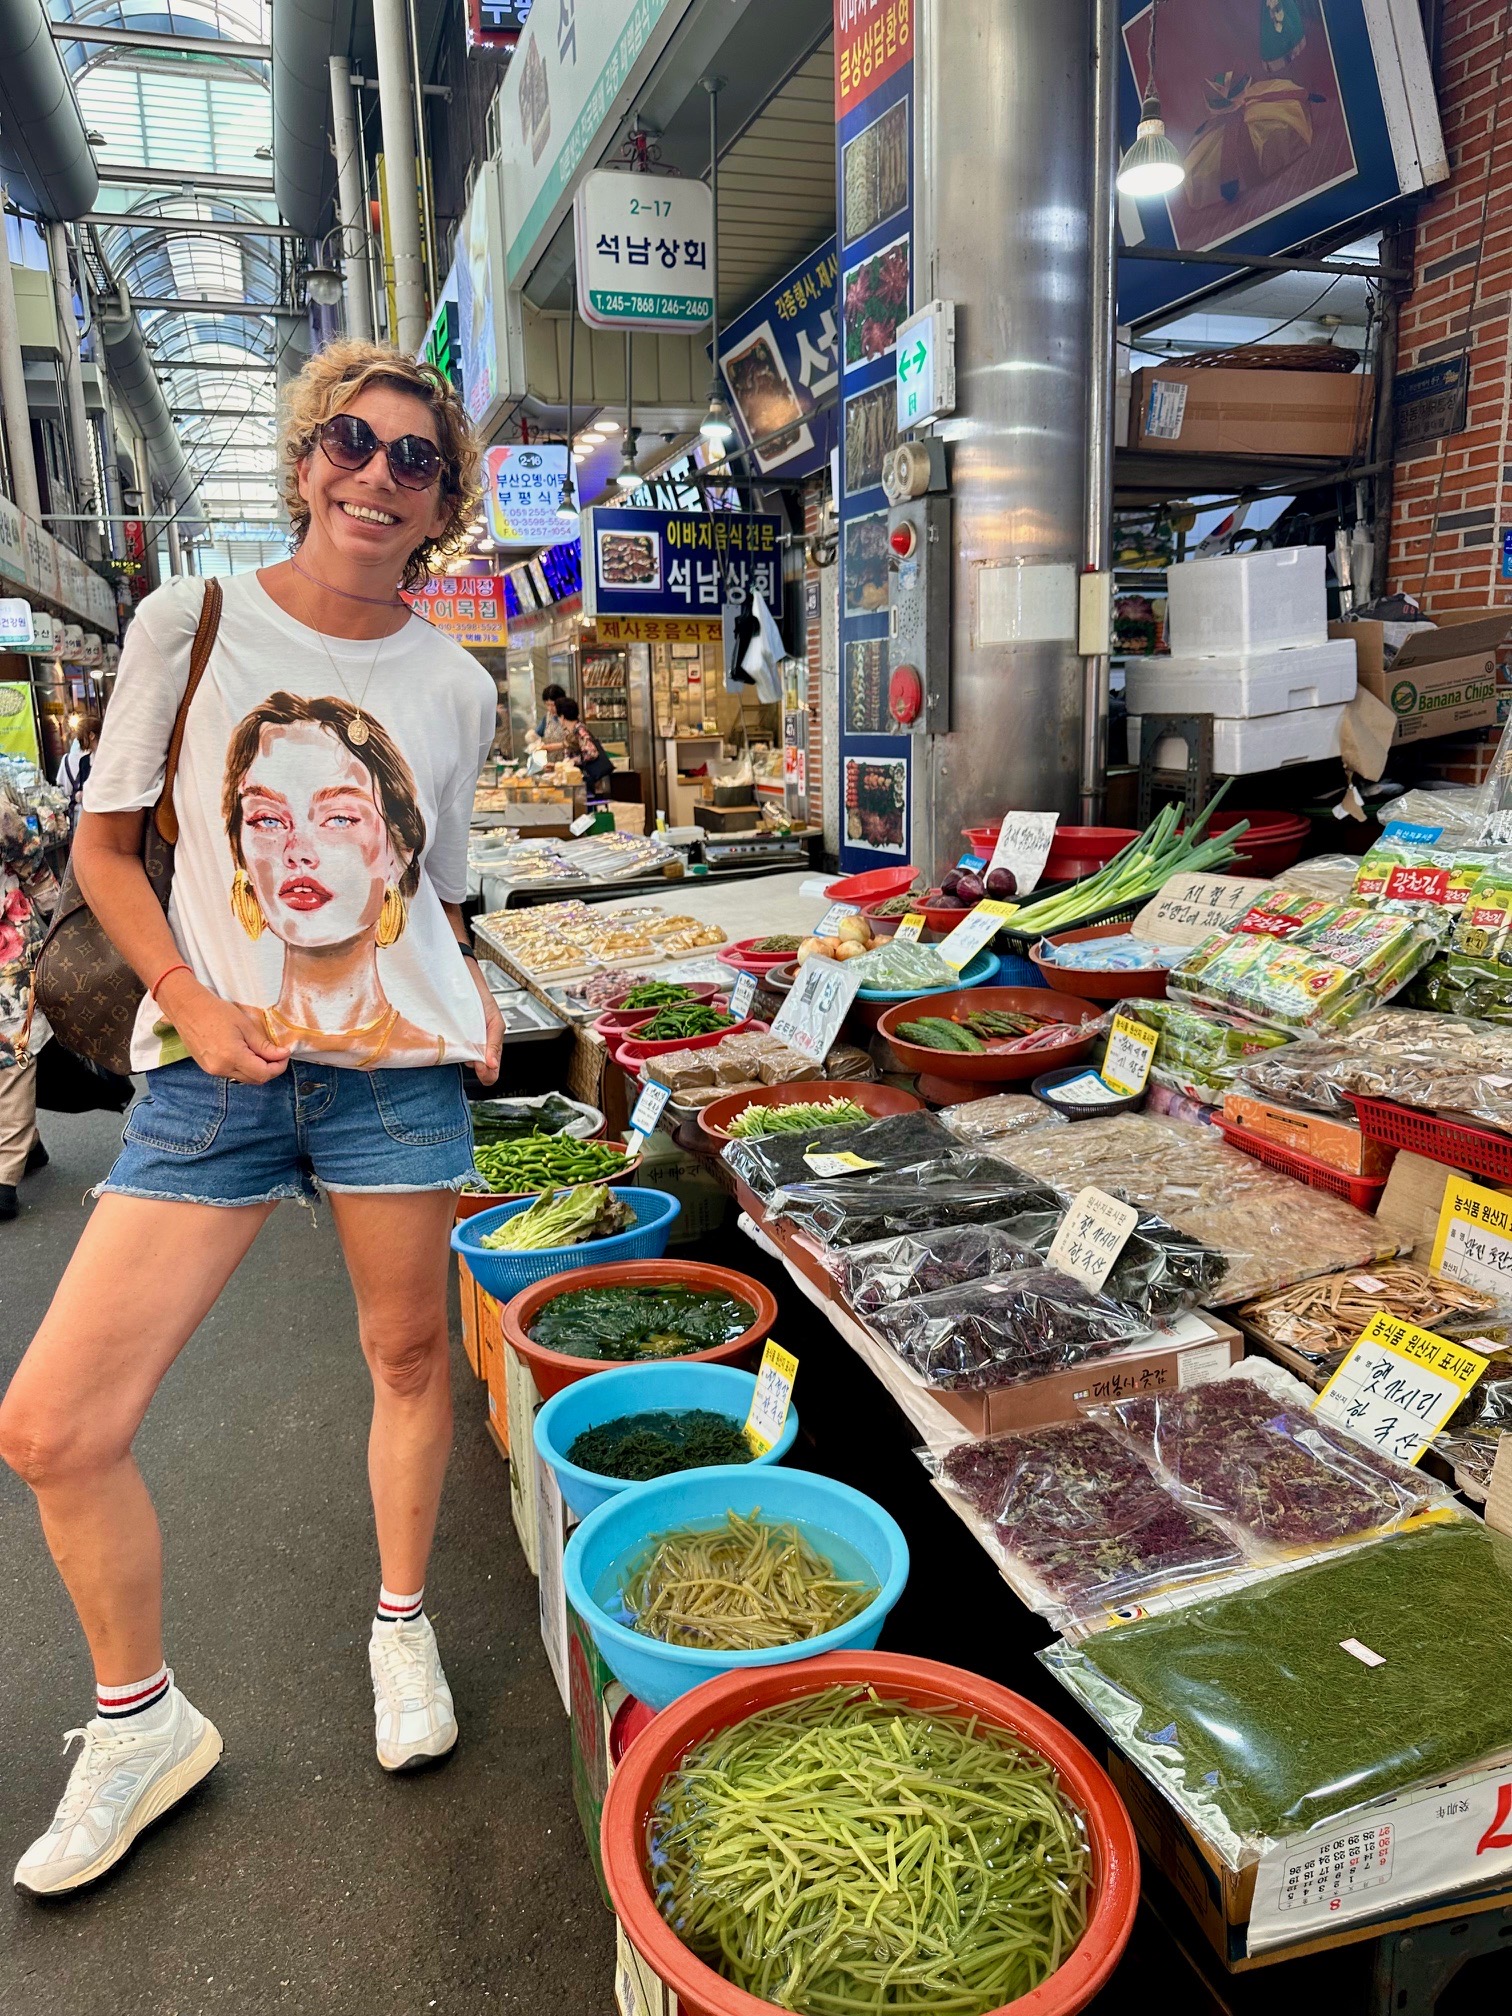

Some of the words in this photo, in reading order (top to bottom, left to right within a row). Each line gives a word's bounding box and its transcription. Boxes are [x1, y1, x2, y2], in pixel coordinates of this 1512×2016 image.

[630, 199, 672, 217] 2-17
[596, 234, 706, 270] 석남상회
[667, 558, 775, 606] 석남상회
[602, 620, 700, 642] 제사용음식
[1417, 688, 1461, 710] Banana
[1464, 680, 1494, 706] Chips
[1393, 872, 1440, 896] 광천김
[1454, 1194, 1480, 1219] 농식품
[1482, 1205, 1509, 1230] 원산지
[1372, 1318, 1407, 1347] 농식품
[1404, 1334, 1442, 1364] 원산지
[1438, 1352, 1477, 1382] 표시판
[1092, 1374, 1135, 1398] 대봉시
[1139, 1369, 1168, 1388] 곶감
[1329, 1389, 1348, 1405] 원산지
[1435, 1799, 1470, 1819] 癸卯年
[1363, 1831, 1374, 1840] 28
[1379, 1827, 1390, 1836] 27
[1333, 1840, 1344, 1849] 30
[1348, 1835, 1359, 1845] 29
[1379, 1838, 1390, 1847] 20
[1320, 1845, 1330, 1854] 31
[1365, 1842, 1375, 1851] 21
[1334, 1851, 1345, 1860] 23
[1349, 1847, 1360, 1856] 22
[1319, 1855, 1330, 1865] 24
[1350, 1857, 1359, 1866] 15
[1364, 1853, 1373, 1861] 14
[1304, 1860, 1315, 1870] 25
[1335, 1862, 1344, 1870] 16
[1380, 1858, 1386, 1866] 6
[1290, 1866, 1301, 1875] 26
[1320, 1867, 1329, 1876] 17
[1289, 1876, 1299, 1884] 19
[1304, 1871, 1314, 1880] 18
[1317, 1876, 1328, 1884] 10
[1330, 1899, 1341, 1910] 8
